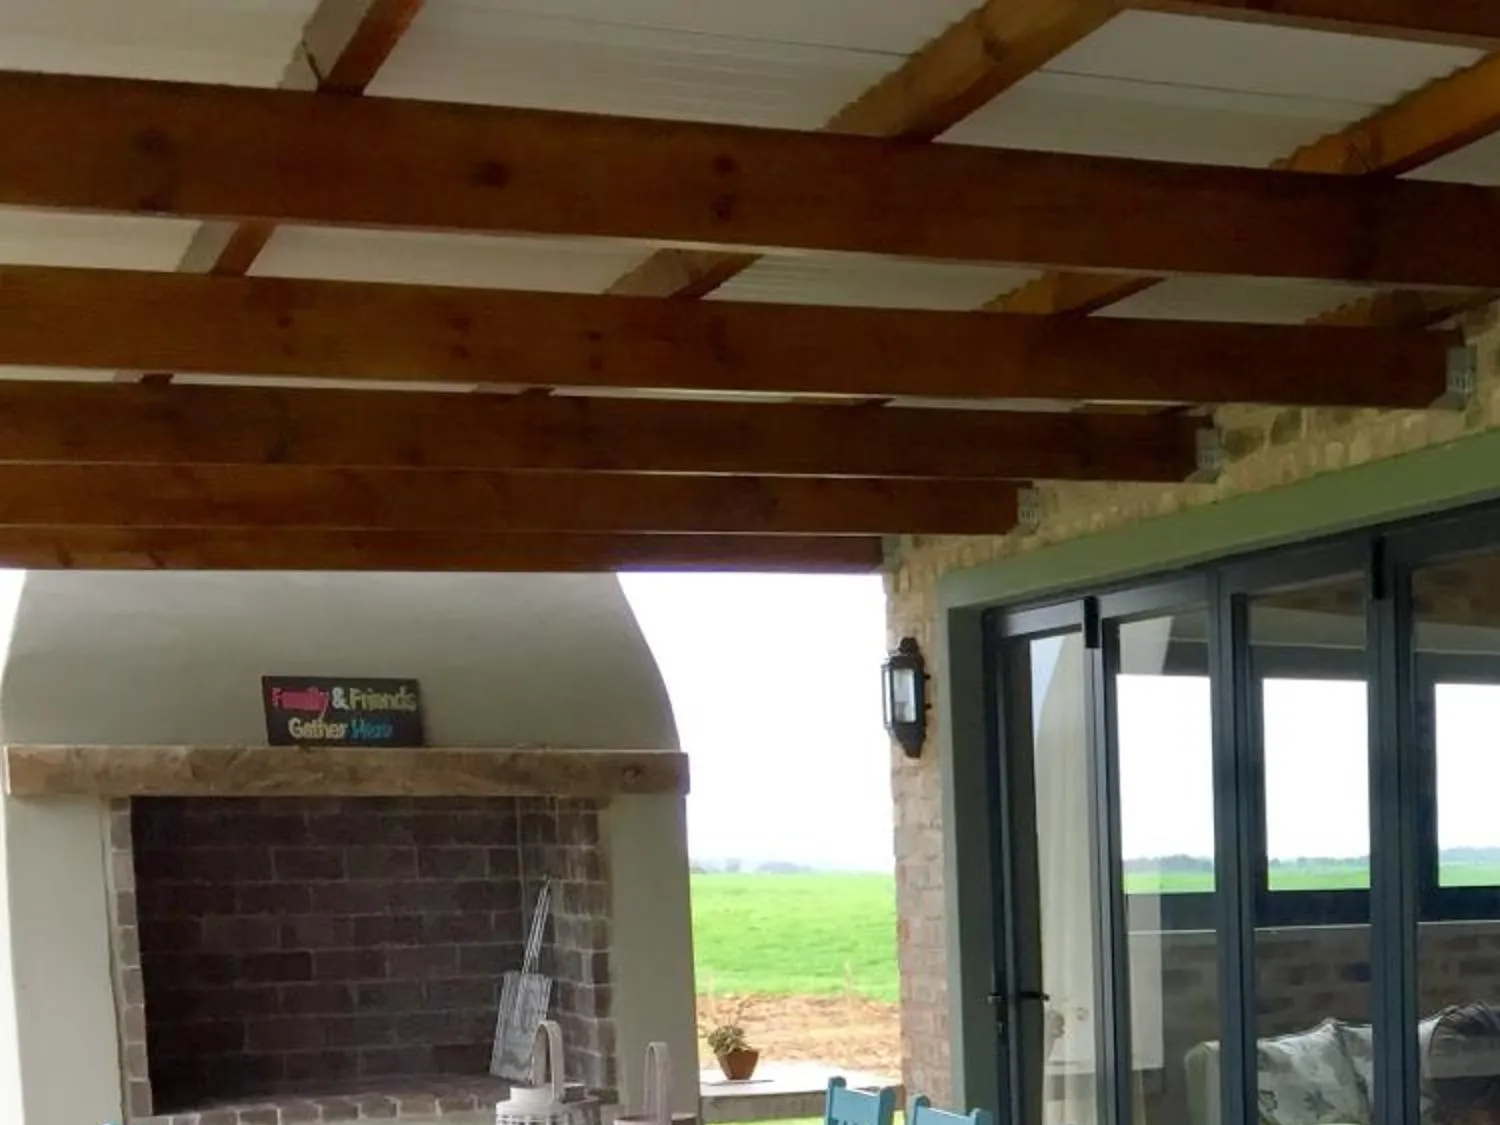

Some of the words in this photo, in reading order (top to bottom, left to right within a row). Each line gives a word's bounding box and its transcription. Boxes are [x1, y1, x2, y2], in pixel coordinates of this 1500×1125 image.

[331, 686, 349, 710] &
[349, 685, 417, 711] Friends
[288, 716, 347, 739] Gather
